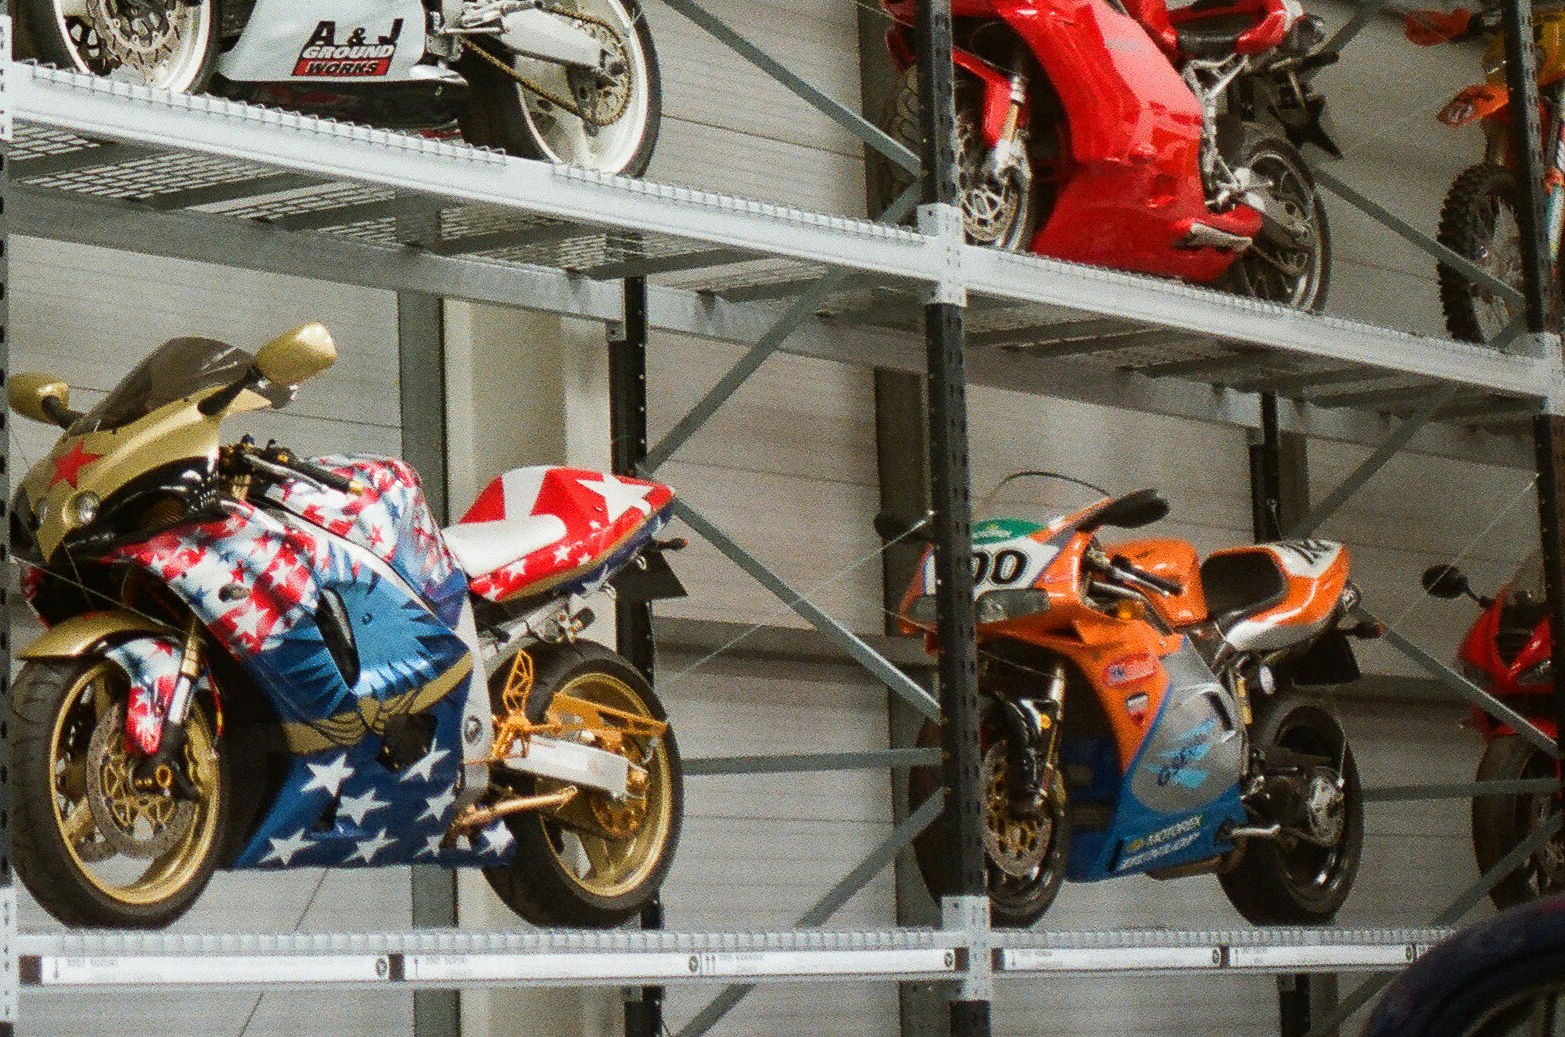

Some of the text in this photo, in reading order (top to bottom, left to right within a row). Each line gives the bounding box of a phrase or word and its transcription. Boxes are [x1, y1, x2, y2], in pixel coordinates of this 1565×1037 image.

[305, 18, 404, 45] A & J
[302, 45, 395, 59] GROUND
[305, 60, 379, 74] WORKS
